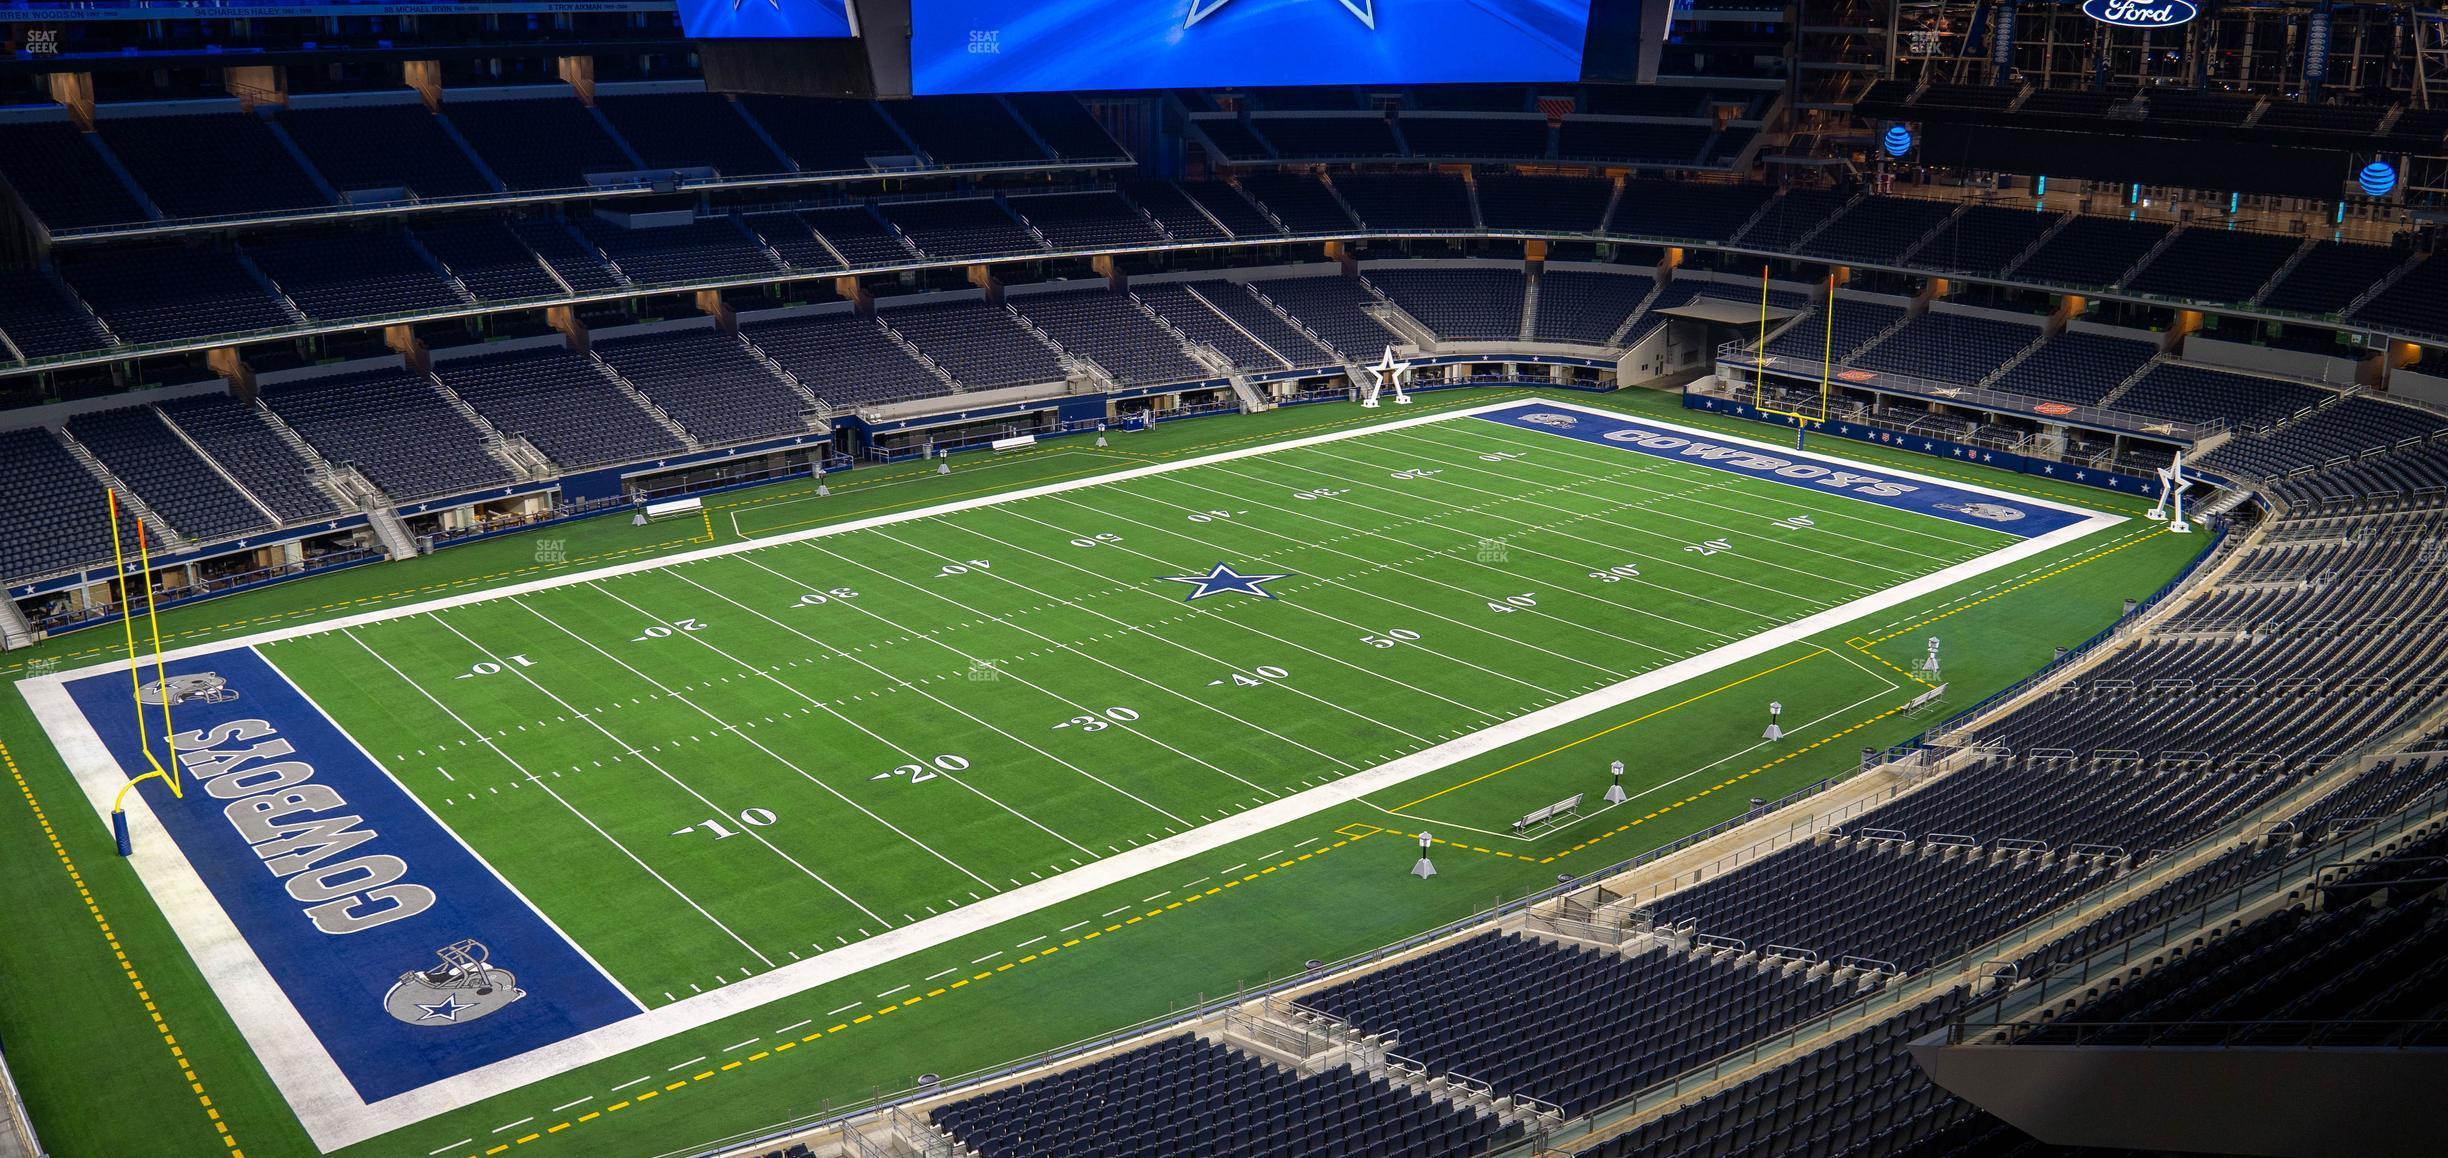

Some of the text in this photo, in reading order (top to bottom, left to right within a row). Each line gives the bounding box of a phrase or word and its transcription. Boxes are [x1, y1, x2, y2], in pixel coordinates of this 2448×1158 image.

[2104, 0, 2174, 22] Ford
[1603, 428, 1920, 497] COWBOYS
[1771, 517, 1814, 531] 10
[1070, 533, 1123, 547] 50
[1683, 540, 1732, 556] 20
[942, 559, 991, 574] 40
[1588, 566, 1639, 583] 30
[800, 587, 859, 604] 30
[1487, 596, 1536, 613] 40
[644, 618, 708, 638] 20
[1359, 628, 1420, 648] 50
[472, 654, 538, 675] 10
[1231, 665, 1288, 687] 40
[1071, 707, 1139, 732] 30
[893, 754, 970, 784] 20
[164, 718, 436, 935] COWBOYS
[697, 808, 777, 841] 10
